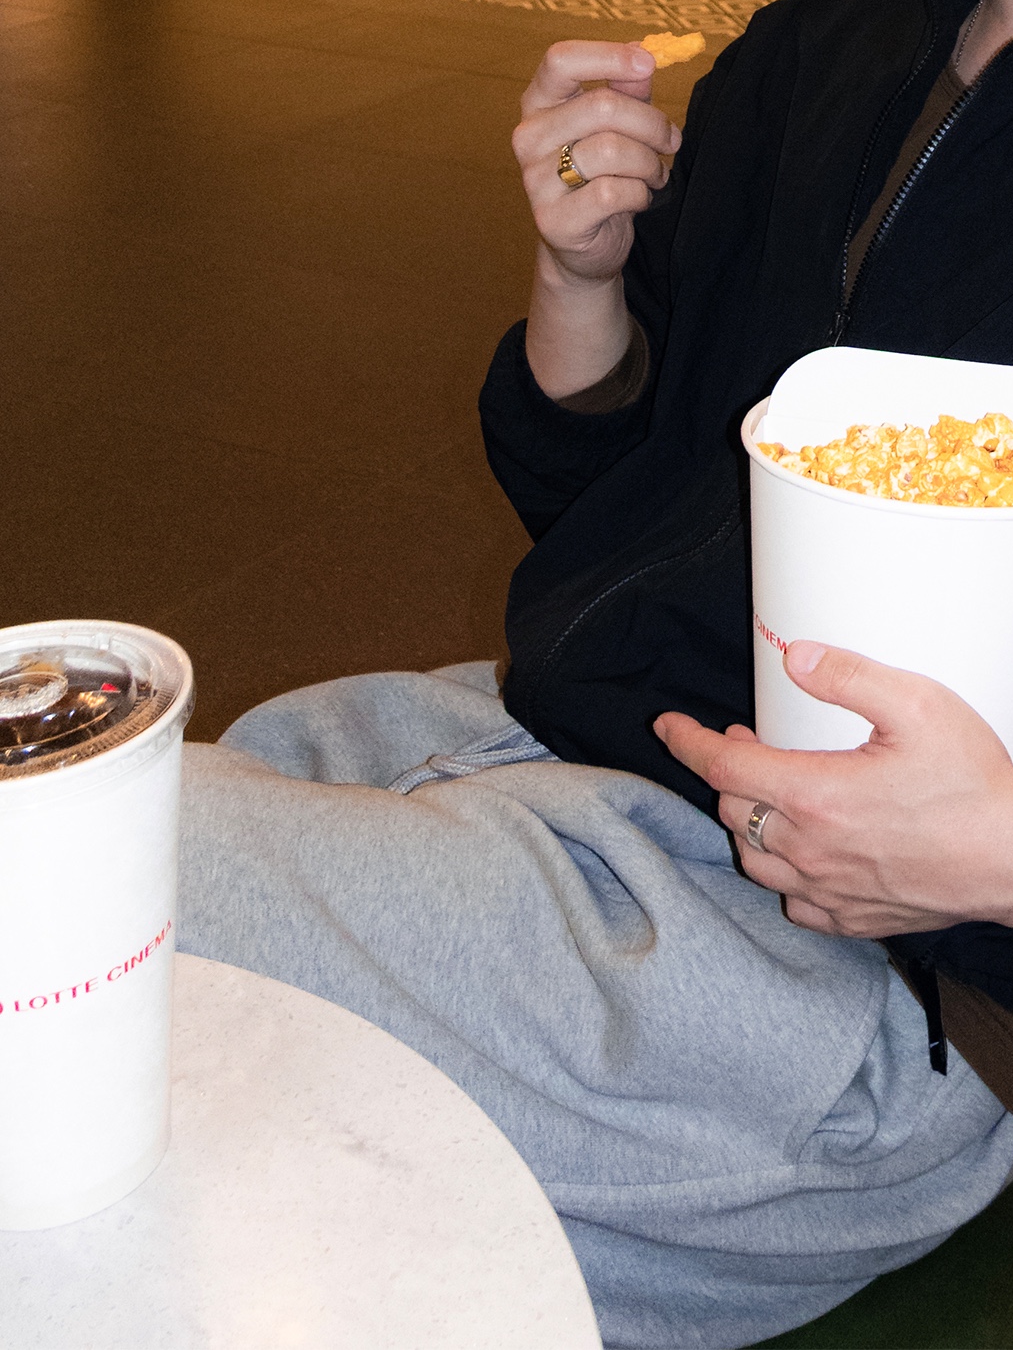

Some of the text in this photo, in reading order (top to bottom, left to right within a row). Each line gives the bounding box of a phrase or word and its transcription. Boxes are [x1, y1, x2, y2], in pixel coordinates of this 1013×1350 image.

[755, 614, 787, 655] CINEM
[14, 919, 172, 1012] LOTTE CINEMA
